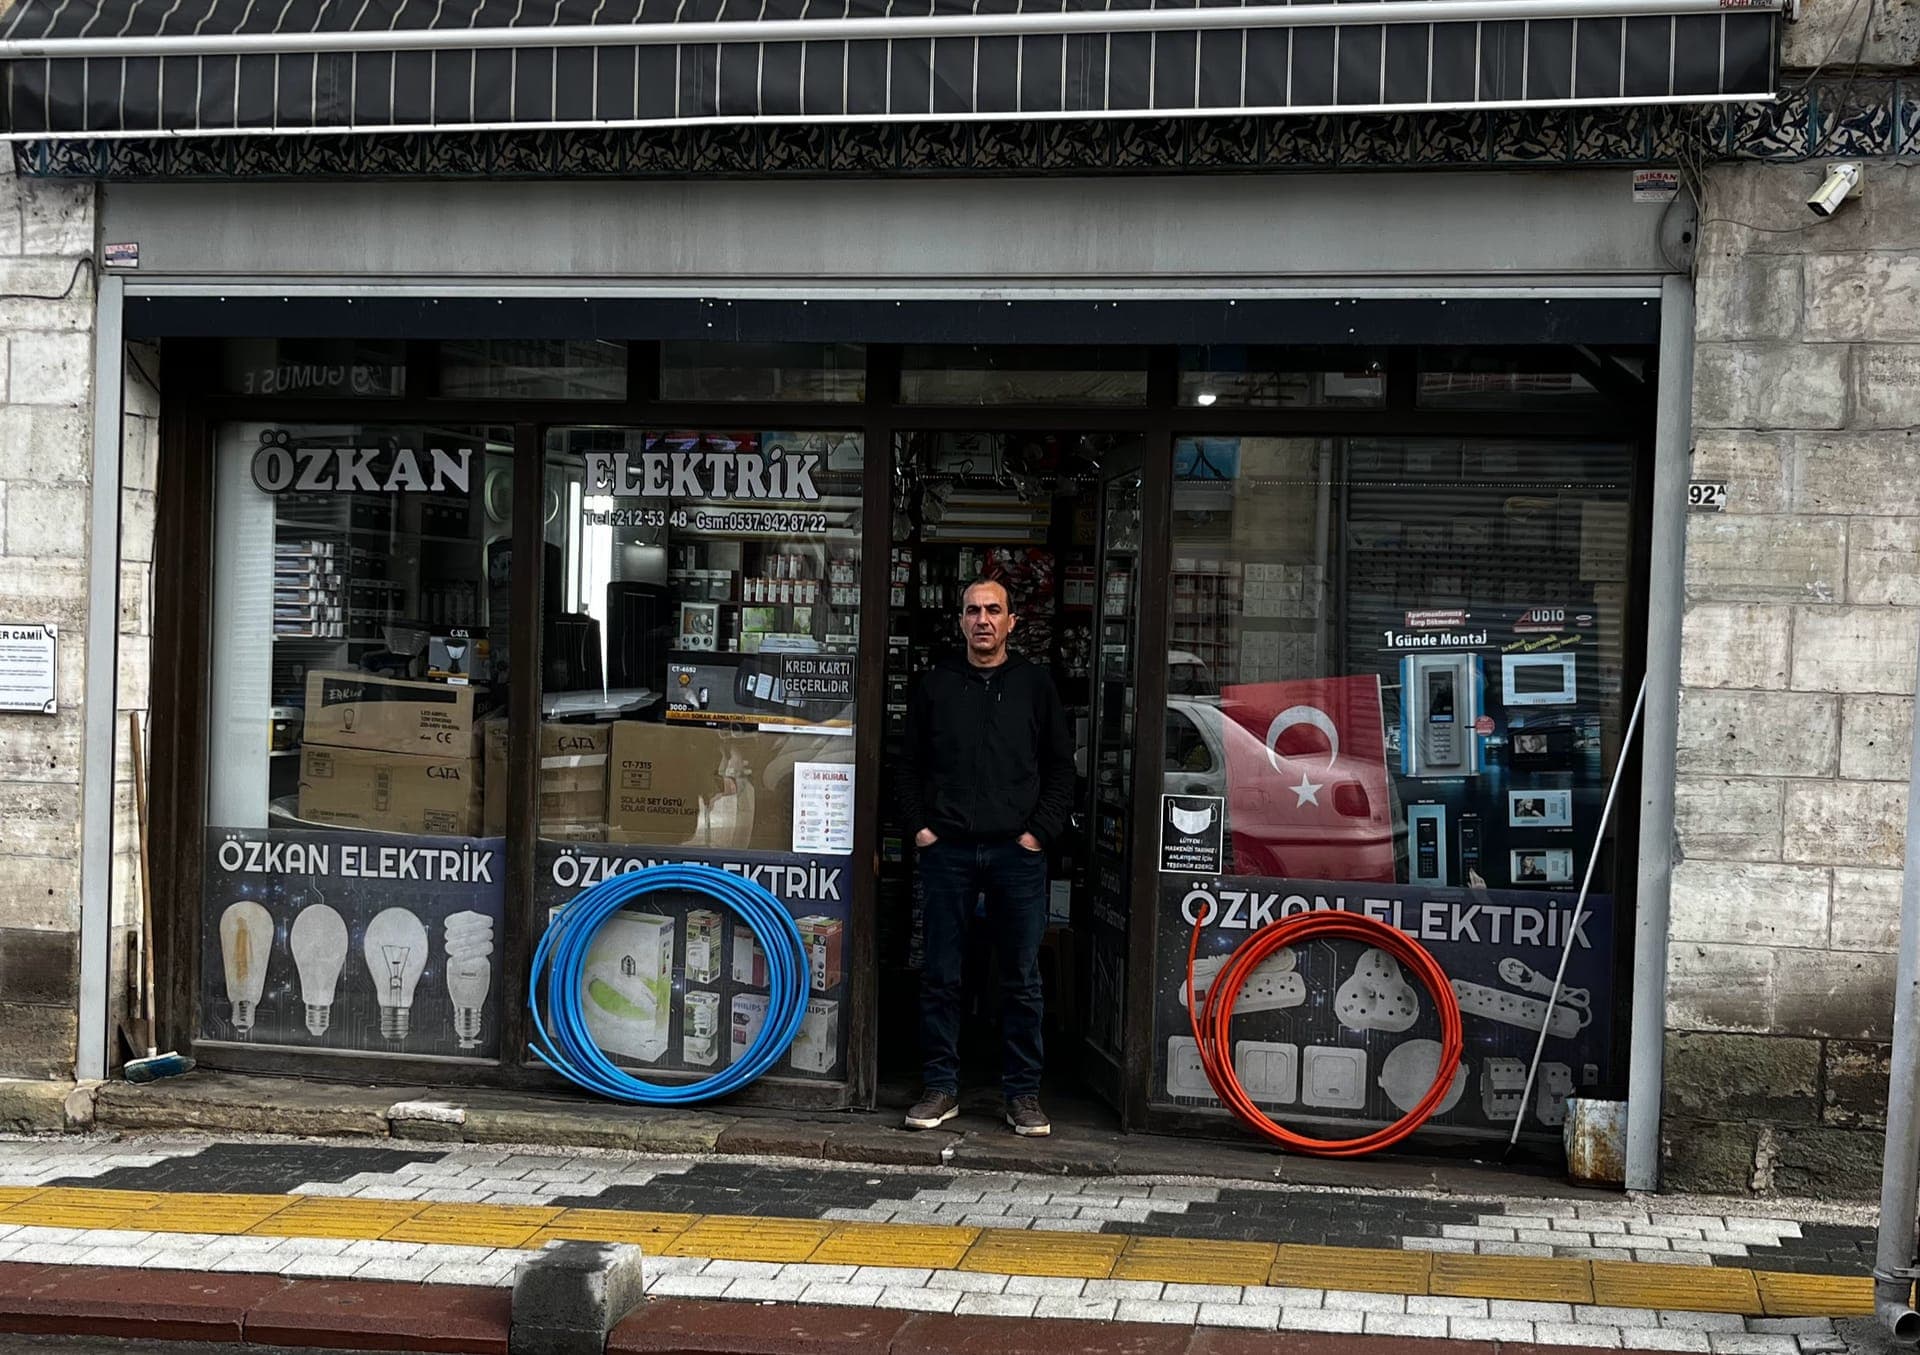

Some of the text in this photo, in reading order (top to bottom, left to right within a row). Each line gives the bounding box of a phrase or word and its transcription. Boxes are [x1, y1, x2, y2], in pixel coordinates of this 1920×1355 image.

[252, 429, 473, 494] ÖZKAN
[1440, 629, 1487, 645] Montaj
[819, 661, 850, 676] KARTI
[558, 735, 596, 751] CATA
[427, 766, 461, 781] CATA
[218, 834, 493, 884] ÖZKAN ELEKTRİK
